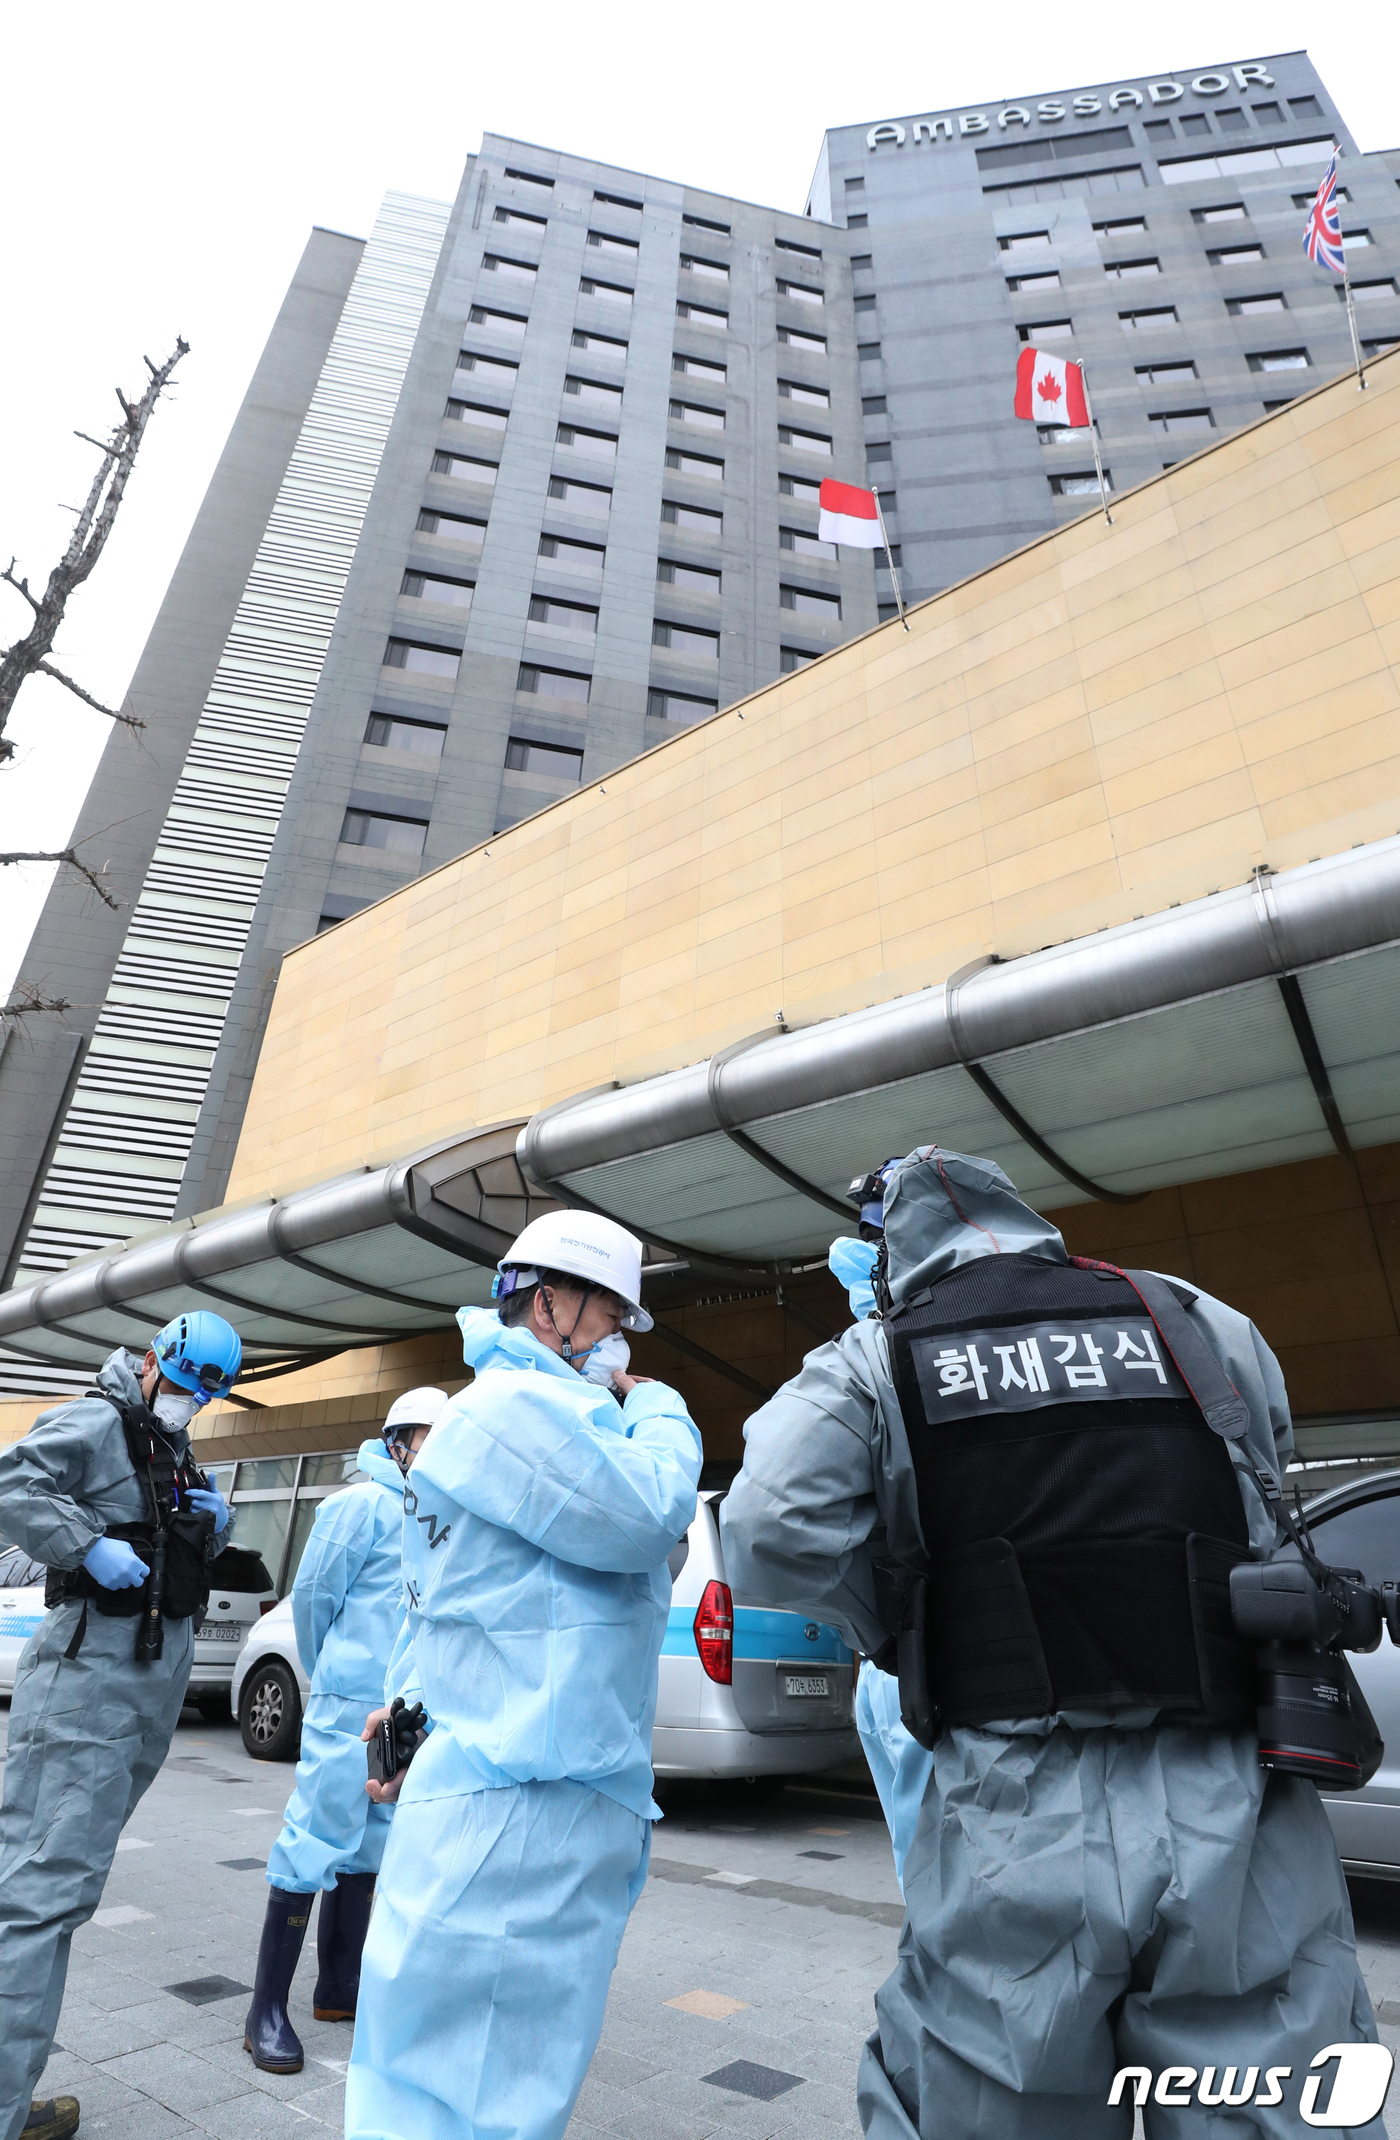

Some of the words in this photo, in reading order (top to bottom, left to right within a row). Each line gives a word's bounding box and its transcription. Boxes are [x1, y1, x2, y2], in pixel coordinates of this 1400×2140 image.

[866, 63, 1275, 150] AMBASSADOR
[932, 1328, 1168, 1400] 화재감식
[215, 1629, 236, 1639] 0202
